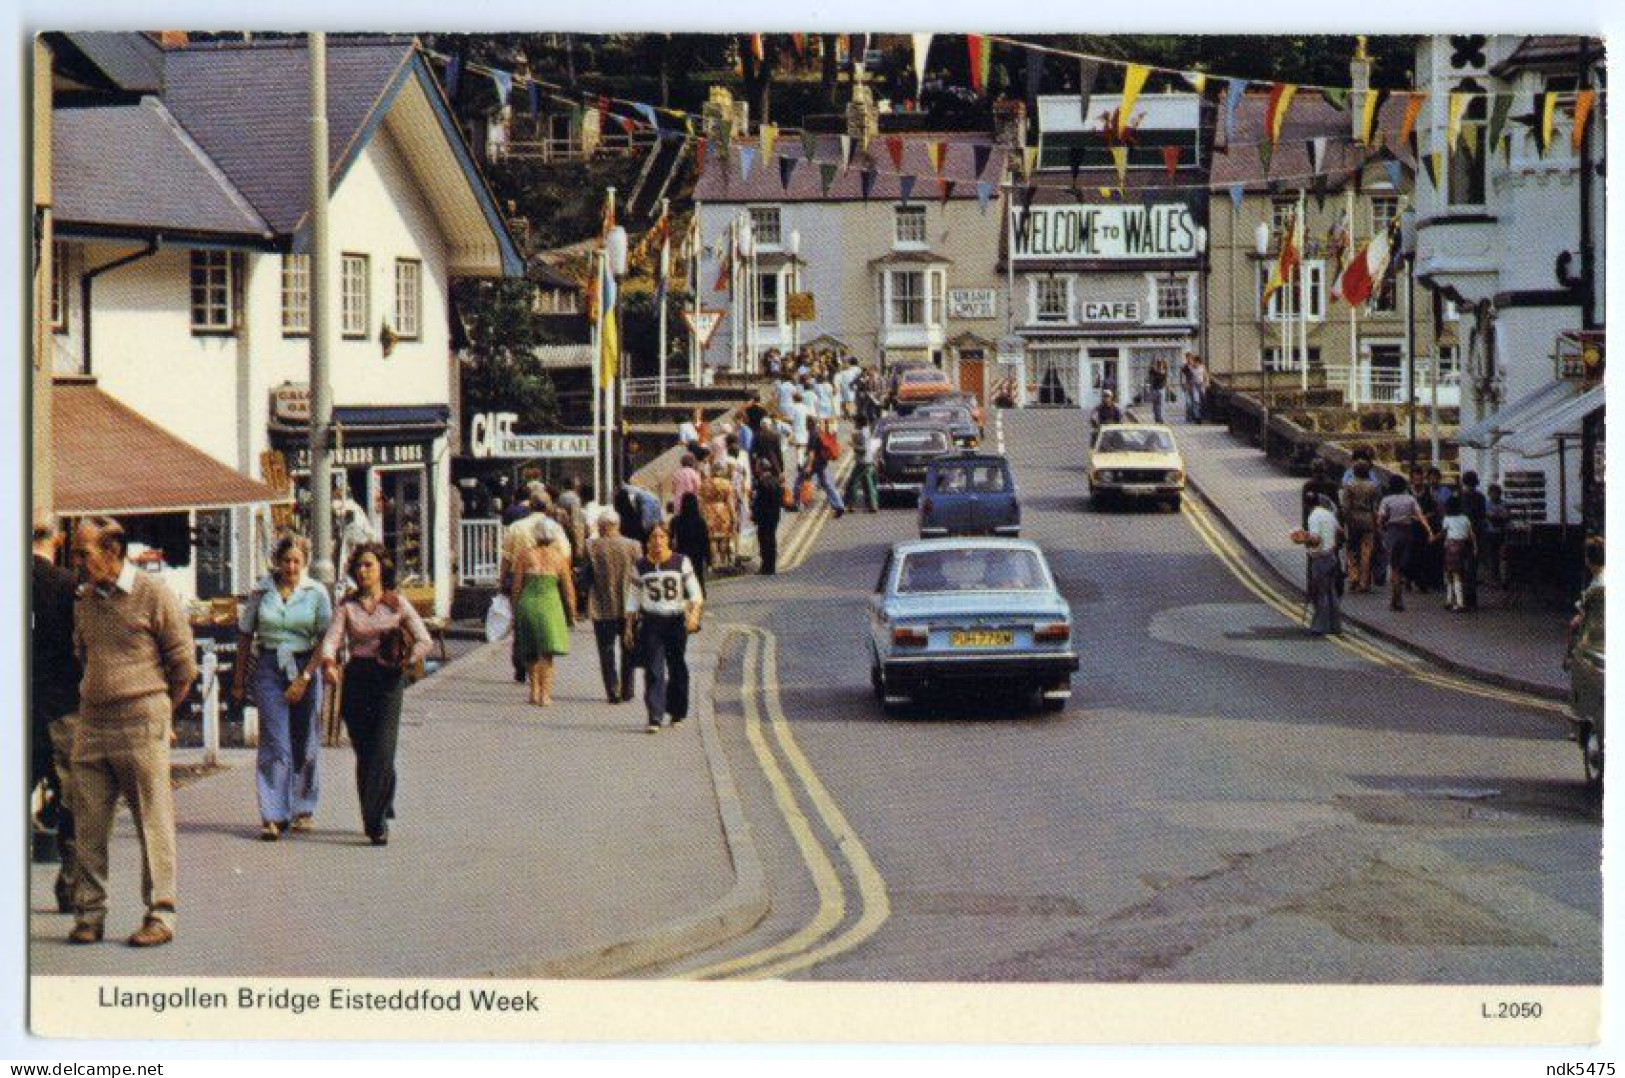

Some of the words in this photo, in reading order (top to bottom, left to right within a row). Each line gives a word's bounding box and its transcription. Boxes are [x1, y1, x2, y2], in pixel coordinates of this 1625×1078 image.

[1012, 210, 1100, 255] WELCOME
[1101, 225, 1120, 240] TO
[1122, 208, 1195, 254] WALES
[1085, 303, 1137, 320] CAFE
[644, 576, 678, 603] 58
